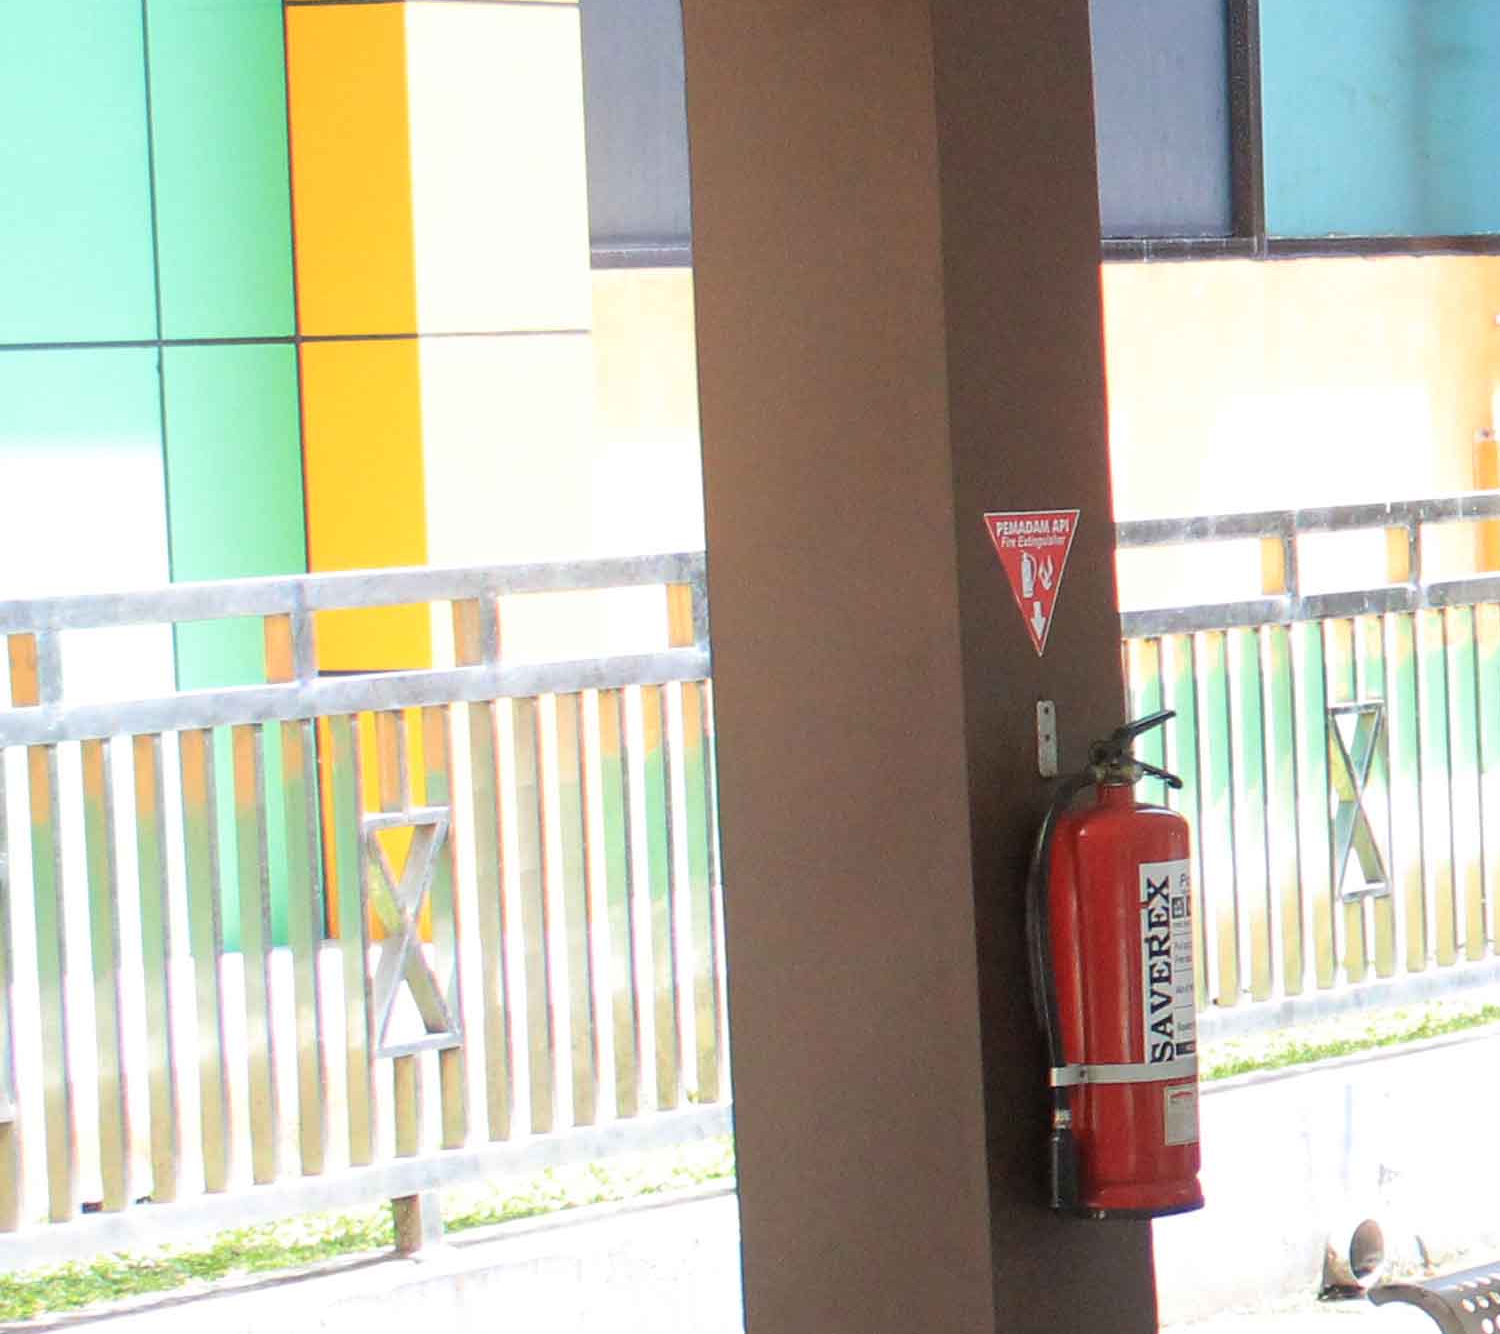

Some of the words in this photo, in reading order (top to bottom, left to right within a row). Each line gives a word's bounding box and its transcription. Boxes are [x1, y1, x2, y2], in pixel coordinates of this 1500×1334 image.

[996, 520, 1050, 537] PEMADAM
[1053, 518, 1070, 533] API
[1146, 874, 1175, 1064] SAVEREX
